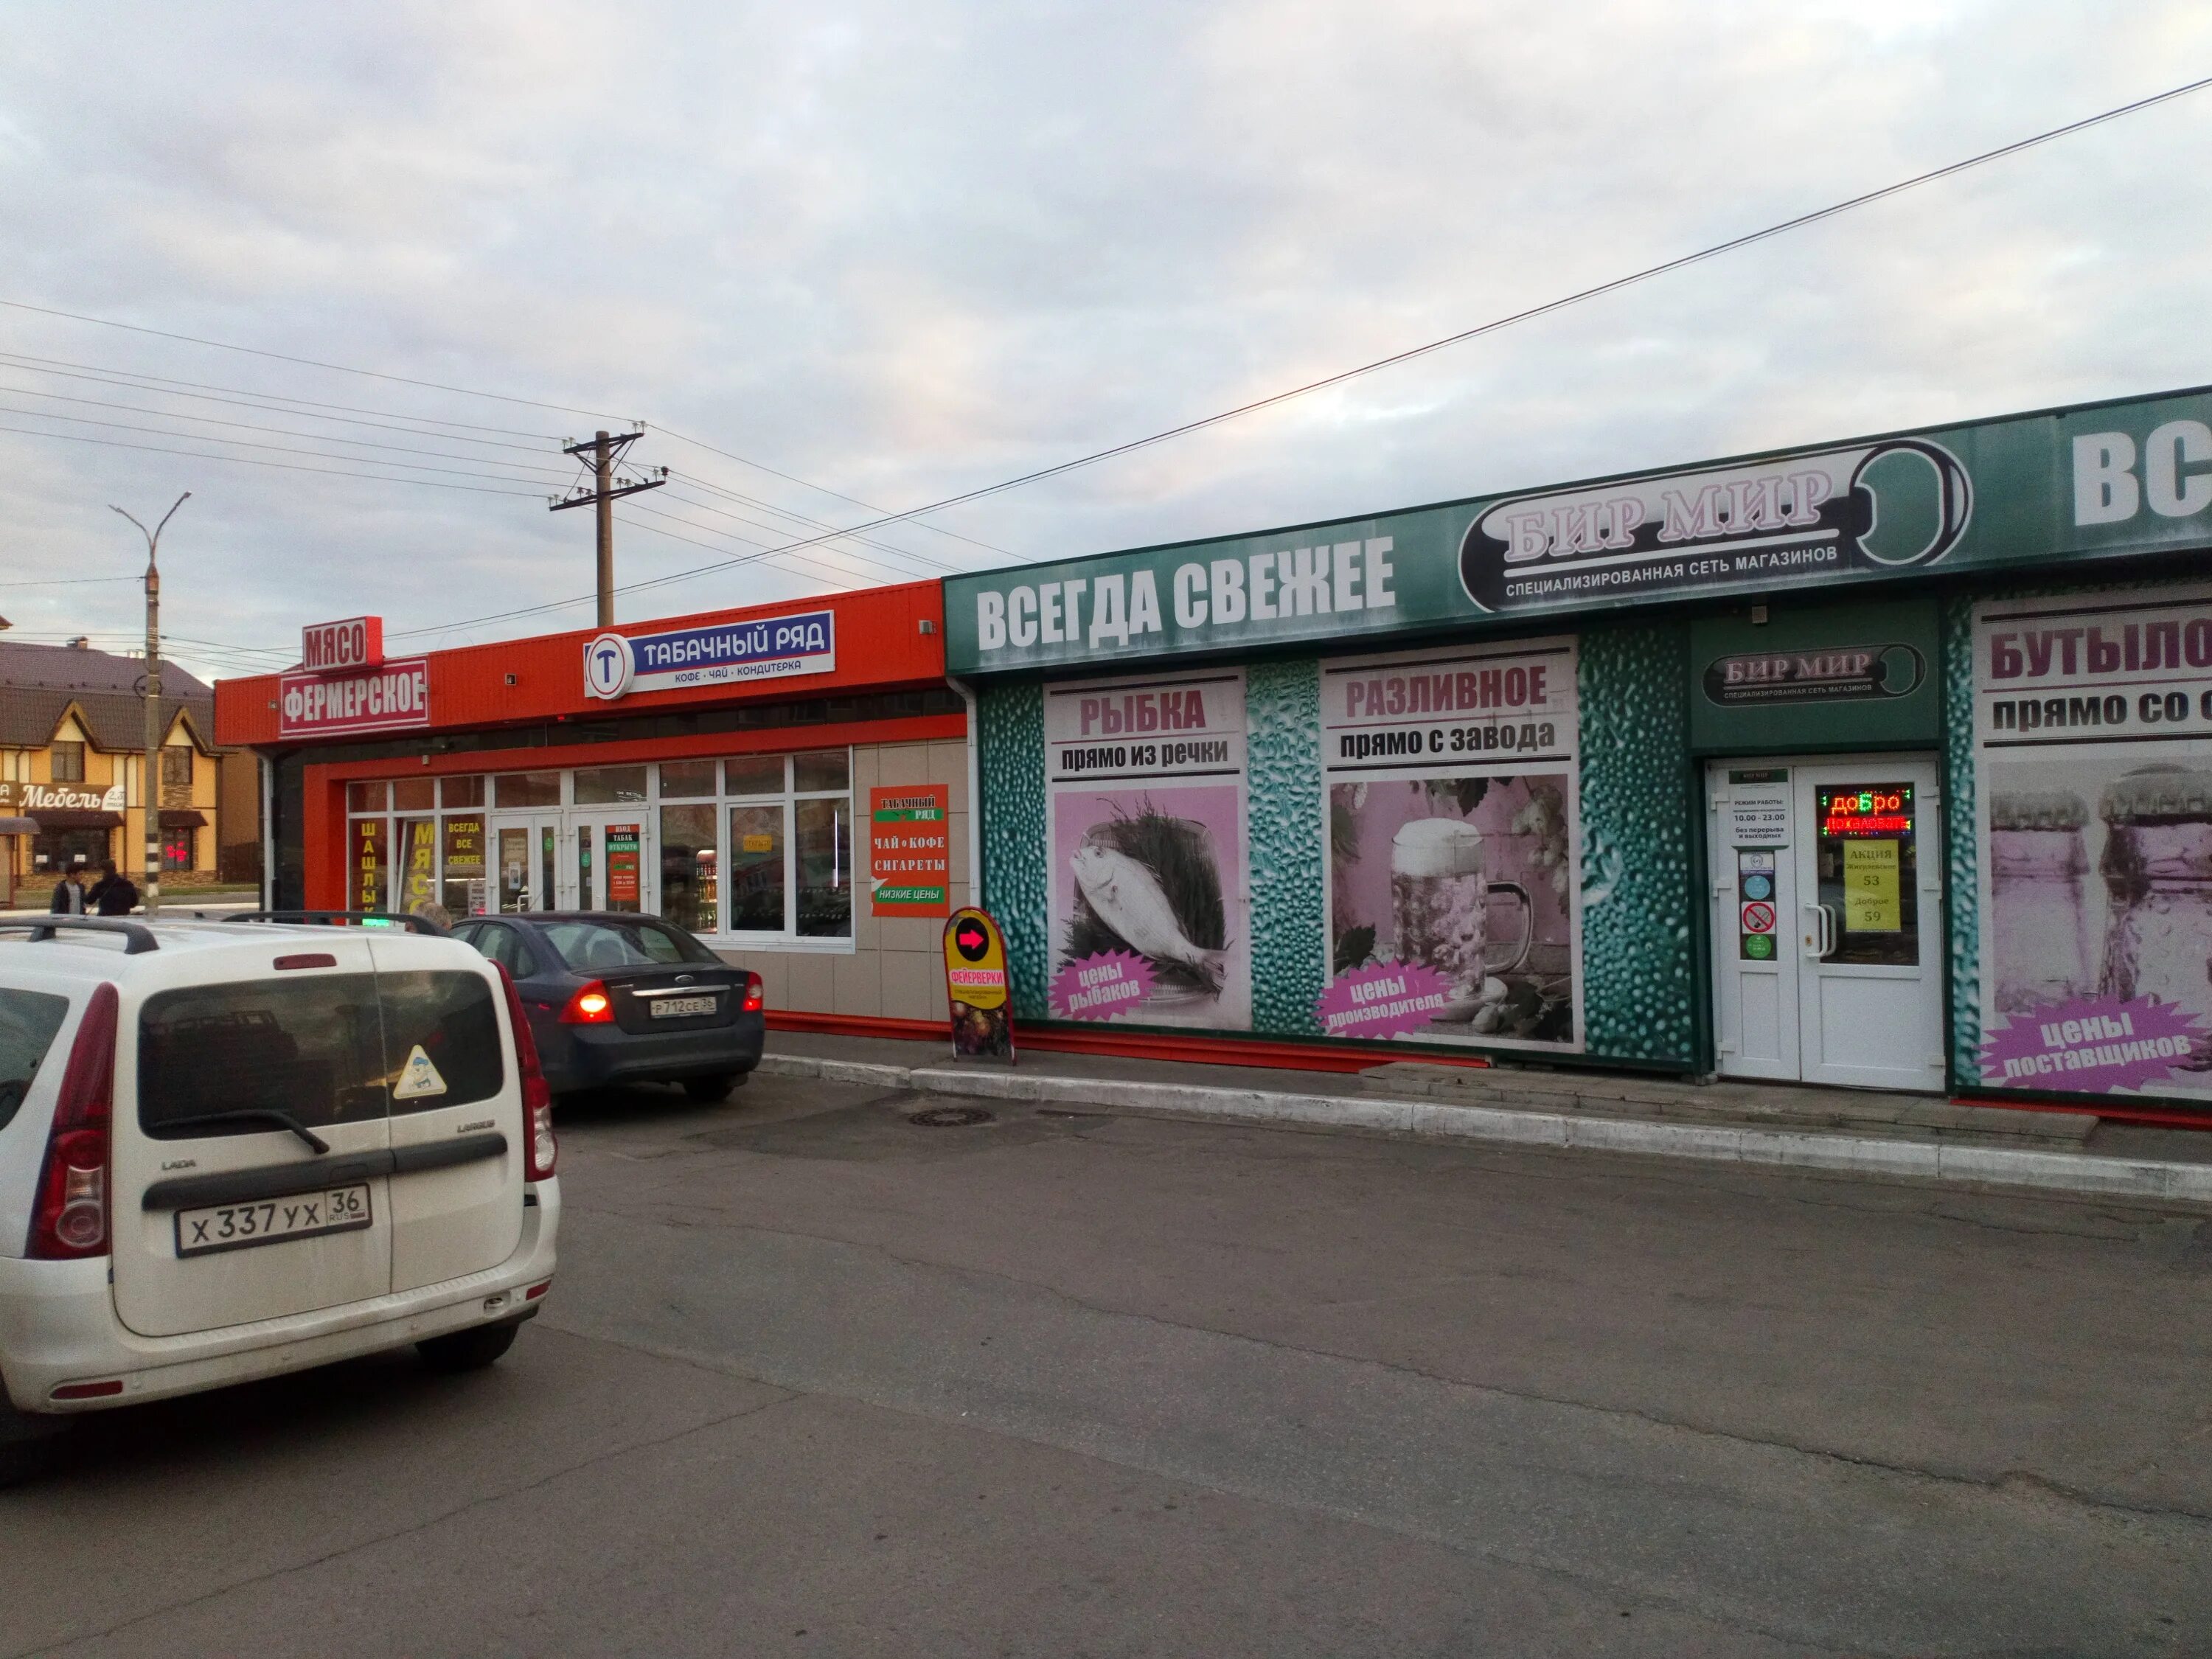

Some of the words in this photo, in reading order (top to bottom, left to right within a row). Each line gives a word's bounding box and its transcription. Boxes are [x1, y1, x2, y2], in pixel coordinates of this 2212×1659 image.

[1504, 496, 1645, 563] БИР
[1657, 469, 1834, 543] МИР
[1506, 563, 1684, 597] СПЕЦИАЛИЗИРОВАННАЯ
[1688, 558, 1730, 577] СЕТЬ
[1735, 546, 1837, 571] МАГАЗИНОВ
[977, 569, 1162, 651] ВСЕГДА
[1173, 536, 1396, 628] СВЕЖЕЕ
[305, 624, 364, 667] МЯСО
[644, 625, 768, 666] ТАБАЧНЫЙ
[776, 622, 825, 650] РЯД
[675, 671, 700, 684] КОФЕ
[709, 667, 728, 679] ЧАЙ
[737, 661, 801, 676] КОНДИТЕРКА
[1724, 659, 1790, 684] БИР
[1795, 653, 1871, 679] МИР
[285, 671, 424, 723] ФЕРМЕРСКОЕ
[1346, 665, 1547, 717] РАЗЛИВНОЕ
[1724, 689, 1806, 699] СПЕЦИАЛИЗИРОВАННАЯ
[1808, 686, 1826, 694] СЕТЬ
[1828, 684, 1872, 693] МАГАЗИНОВ
[1080, 690, 1206, 736] РЫБКА
[1993, 695, 2127, 732] прямо
[2139, 692, 2189, 723] со
[1340, 730, 1422, 759] прямо
[1429, 729, 1444, 752] с
[1450, 722, 1555, 752] завода
[1062, 745, 1126, 772] прямо
[1131, 745, 1156, 767] из
[1161, 740, 1228, 768] речки
[19, 785, 102, 808] Мебель
[881, 794, 936, 809] ТАБАЧНЫЙ
[914, 810, 936, 820] РЯД
[448, 822, 480, 833] ВСЕГДА
[456, 838, 472, 849] ВСЕ
[874, 835, 899, 849] ЧАЙ
[909, 836, 945, 849] КОФЕ
[448, 855, 481, 865] СВЕЖЕЕ
[874, 859, 945, 872] СИГАРЕТЫ
[1851, 850, 1892, 860] АКЦИЯ
[1863, 875, 1879, 886] 53
[879, 889, 912, 899] НИЗКИЕ
[914, 889, 939, 900] ЦЕНЫ
[1854, 897, 1889, 906] Доброе
[1864, 911, 1881, 922] 59
[951, 968, 1004, 984] ФЕЙЕРВЕРКИ
[1078, 961, 1123, 988] цены
[1068, 979, 1141, 1012] рыбаков
[1350, 975, 1406, 1005] цены
[1328, 993, 1445, 1030] производителя
[2040, 1012, 2135, 1049] цены
[2004, 1035, 2192, 1079] поставщиков
[457, 1119, 495, 1133] LARGUS
[161, 1159, 196, 1171] LADA
[333, 1192, 359, 1214] 36
[329, 1211, 350, 1224] RUS
